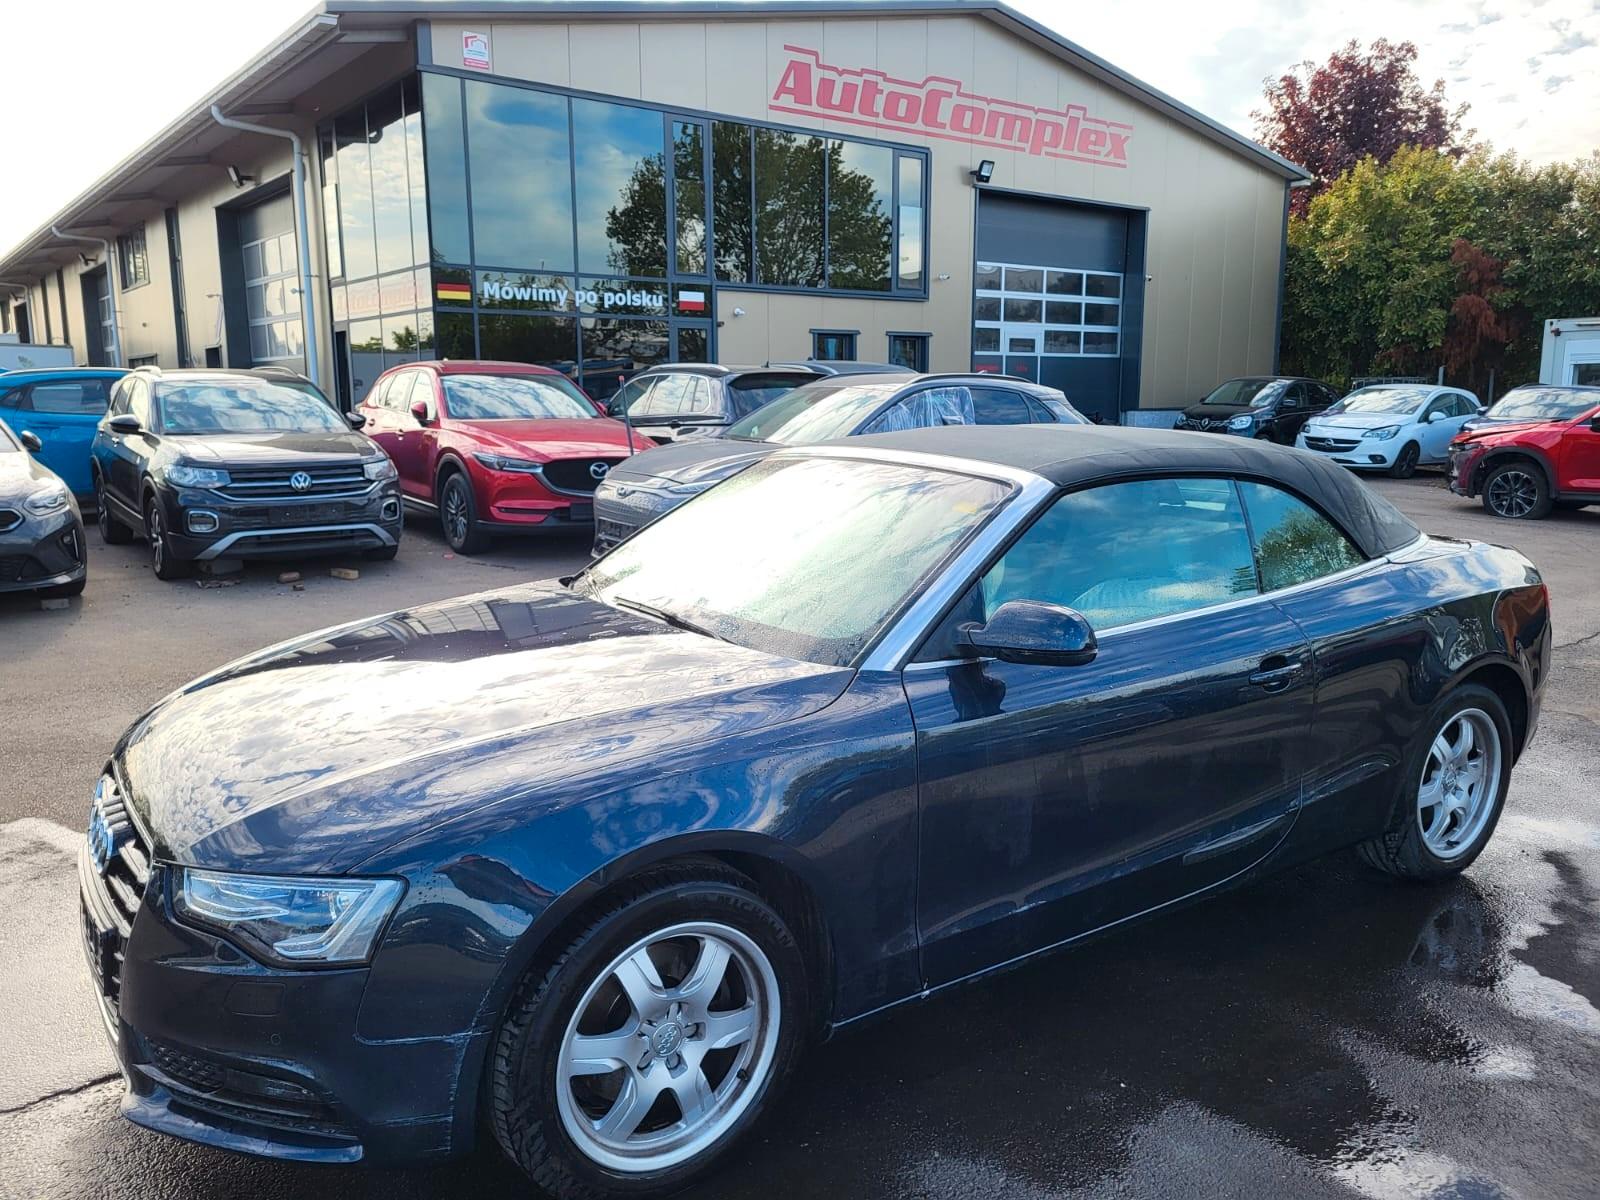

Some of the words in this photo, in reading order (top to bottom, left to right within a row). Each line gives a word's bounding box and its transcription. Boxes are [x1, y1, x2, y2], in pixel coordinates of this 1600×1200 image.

[773, 59, 1131, 160] AutoComplex
[483, 281, 568, 307] Mówimy
[575, 289, 598, 308] po
[604, 290, 664, 308] polsku
[719, 896, 794, 948] MICHELIN
